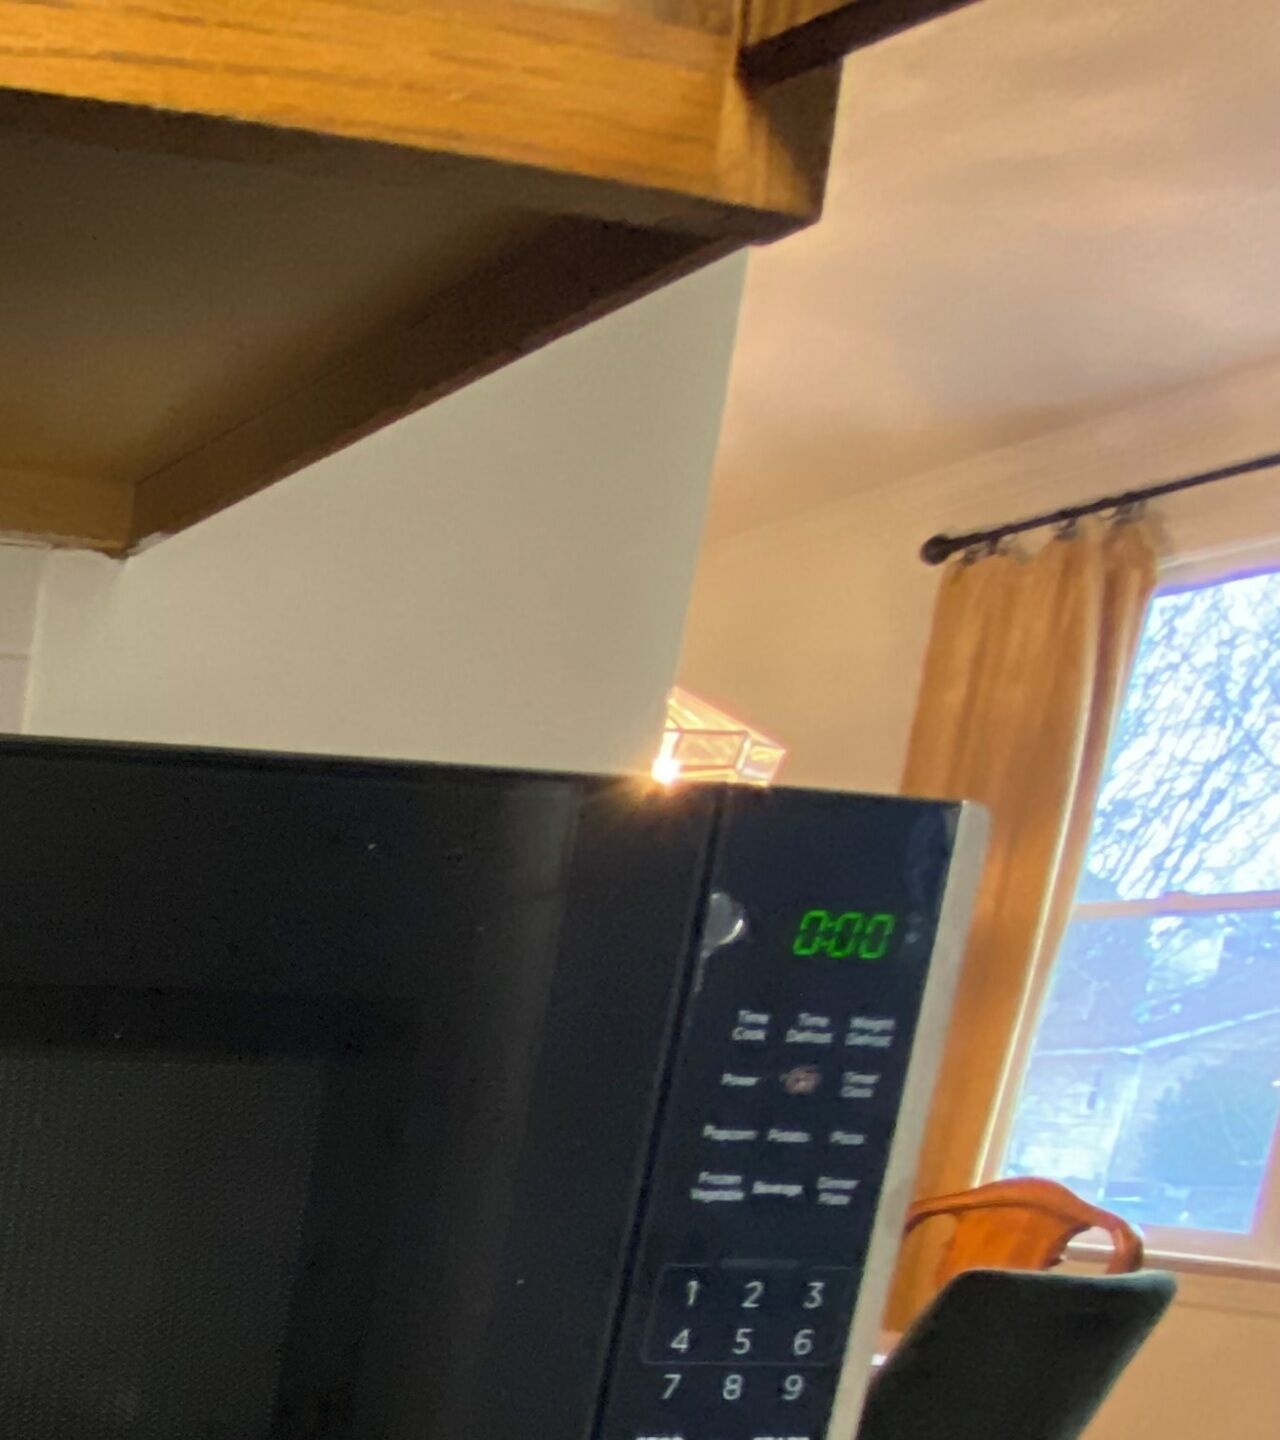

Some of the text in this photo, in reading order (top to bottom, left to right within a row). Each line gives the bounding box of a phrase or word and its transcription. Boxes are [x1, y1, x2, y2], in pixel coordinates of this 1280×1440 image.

[793, 910, 896, 958] 0:00
[686, 1281, 825, 1308] 1 2 3
[670, 1328, 815, 1355] 4 5 6
[661, 1374, 804, 1400] 7 8 9
